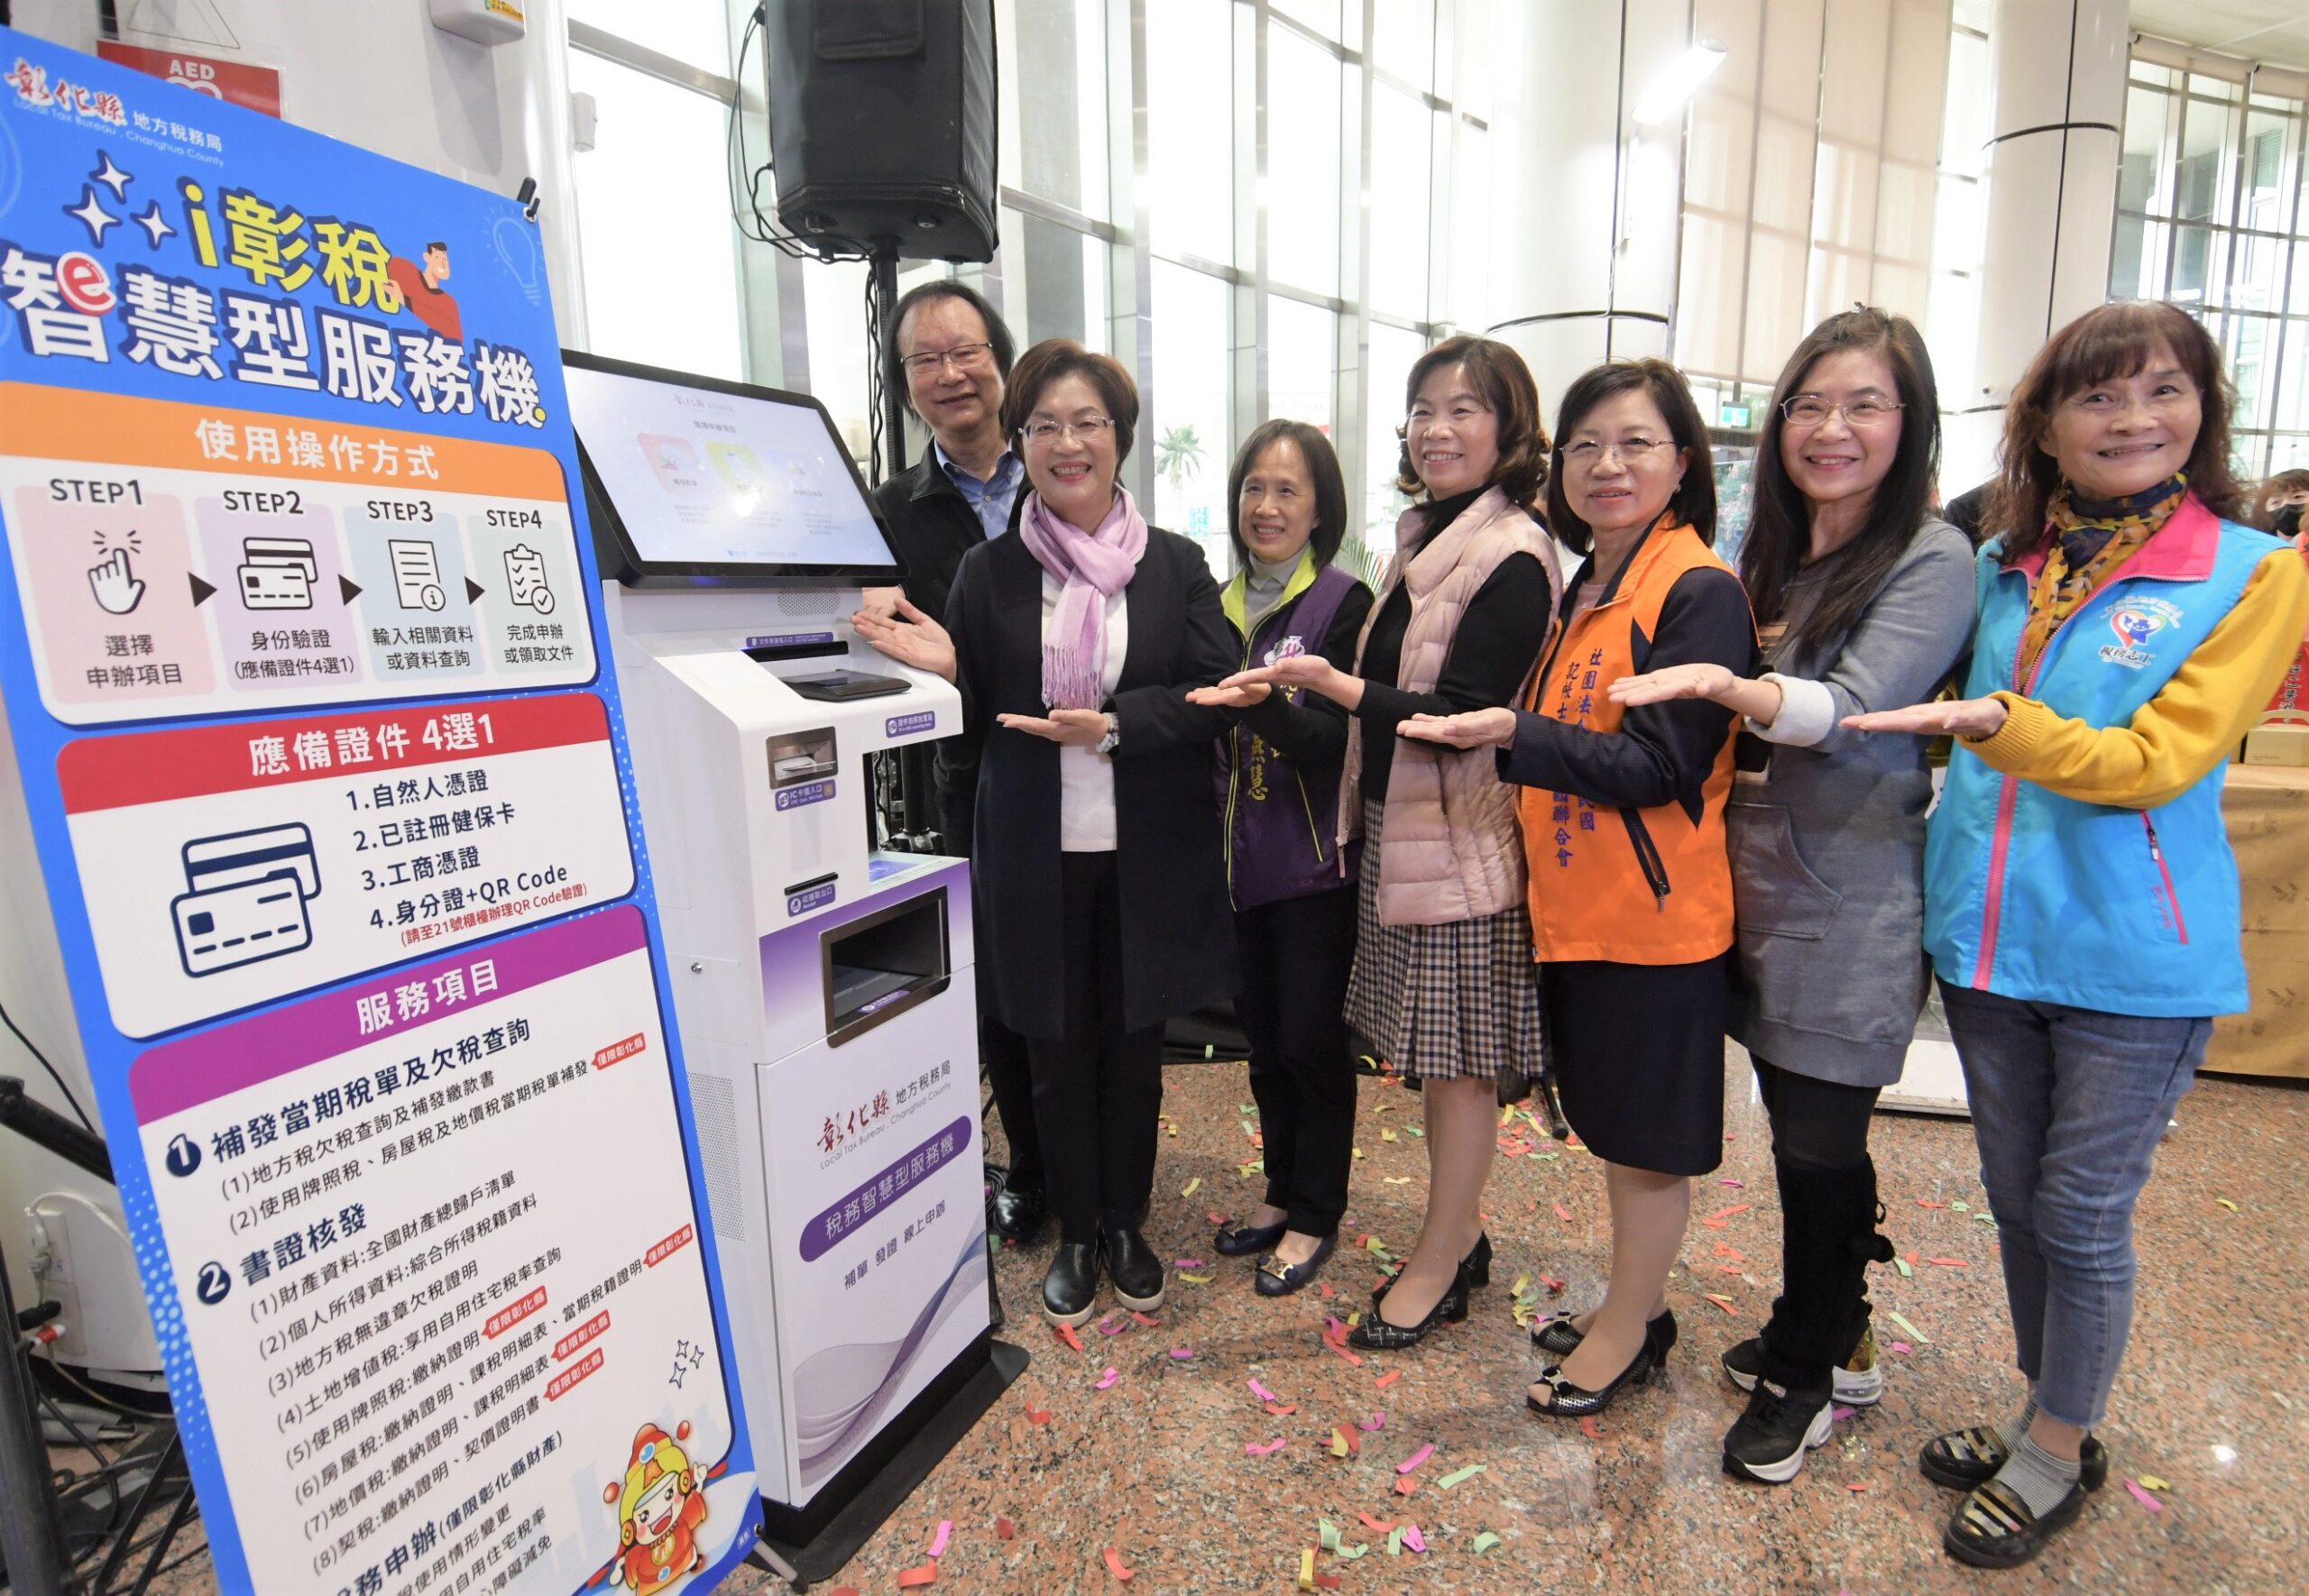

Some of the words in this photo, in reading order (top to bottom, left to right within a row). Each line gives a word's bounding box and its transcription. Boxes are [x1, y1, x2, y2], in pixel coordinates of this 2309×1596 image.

[169, 60, 215, 80] AED
[5, 57, 127, 126] 彰化縣
[133, 111, 223, 152] 地方稅務局
[125, 130, 184, 155] Changhua
[187, 148, 224, 168] County
[186, 183, 400, 314] i彰稅
[195, 418, 439, 480] 使用操作方式
[50, 478, 143, 505] STEP1
[223, 491, 304, 515] STEP2
[367, 501, 433, 522] STEP3
[486, 509, 542, 528] STEP4
[105, 634, 154, 656] 選擇
[251, 628, 331, 650] 身份驗證
[373, 625, 474, 646] 輸入相關資料
[507, 624, 564, 641] 完成申辦
[87, 664, 182, 688] 申辦項目
[234, 656, 354, 680] (應備證件4選1)
[386, 649, 470, 671] 或資料查詢
[503, 645, 574, 664] 或領取文件
[248, 721, 410, 776] 應備證件
[421, 713, 495, 750] 4選1
[346, 769, 489, 811] 1.自然人憑證
[353, 802, 515, 851] 2.已註冊健保卡
[361, 846, 480, 891] 3.工商憑證
[370, 877, 511, 929] 4.身分證+QR
[517, 865, 567, 892] Code
[533, 883, 587, 909] Code驗證)
[356, 959, 498, 1035] 服務項目
[597, 1037, 645, 1066] 僅限彰化縣
[211, 1017, 530, 1163] 補發當期稅單及欠稅查詢
[817, 1090, 889, 1152] 彰化縣
[896, 1060, 951, 1105] 地方稅務局
[222, 1069, 494, 1201] (1)地方稅欠稅查詢及補發繳款書
[820, 1150, 842, 1169] Local
[844, 1142, 857, 1154] Tax
[859, 1124, 885, 1145] Bureau
[890, 1096, 926, 1124] Changhua
[928, 1081, 952, 1101] County
[825, 1133, 954, 1240] 稅務智慧型服務機
[240, 1203, 367, 1287] 書證核發
[268, 1260, 478, 1398] (3)地方稅無違章欠稅證明
[489, 1290, 545, 1335] 僅限彰化縣
[557, 1314, 608, 1357] 僅限彰化縣
[550, 1353, 602, 1397] 僅限彰化縣
[337, 1430, 562, 1596] 務申辦(僅限彰化縣財產)
